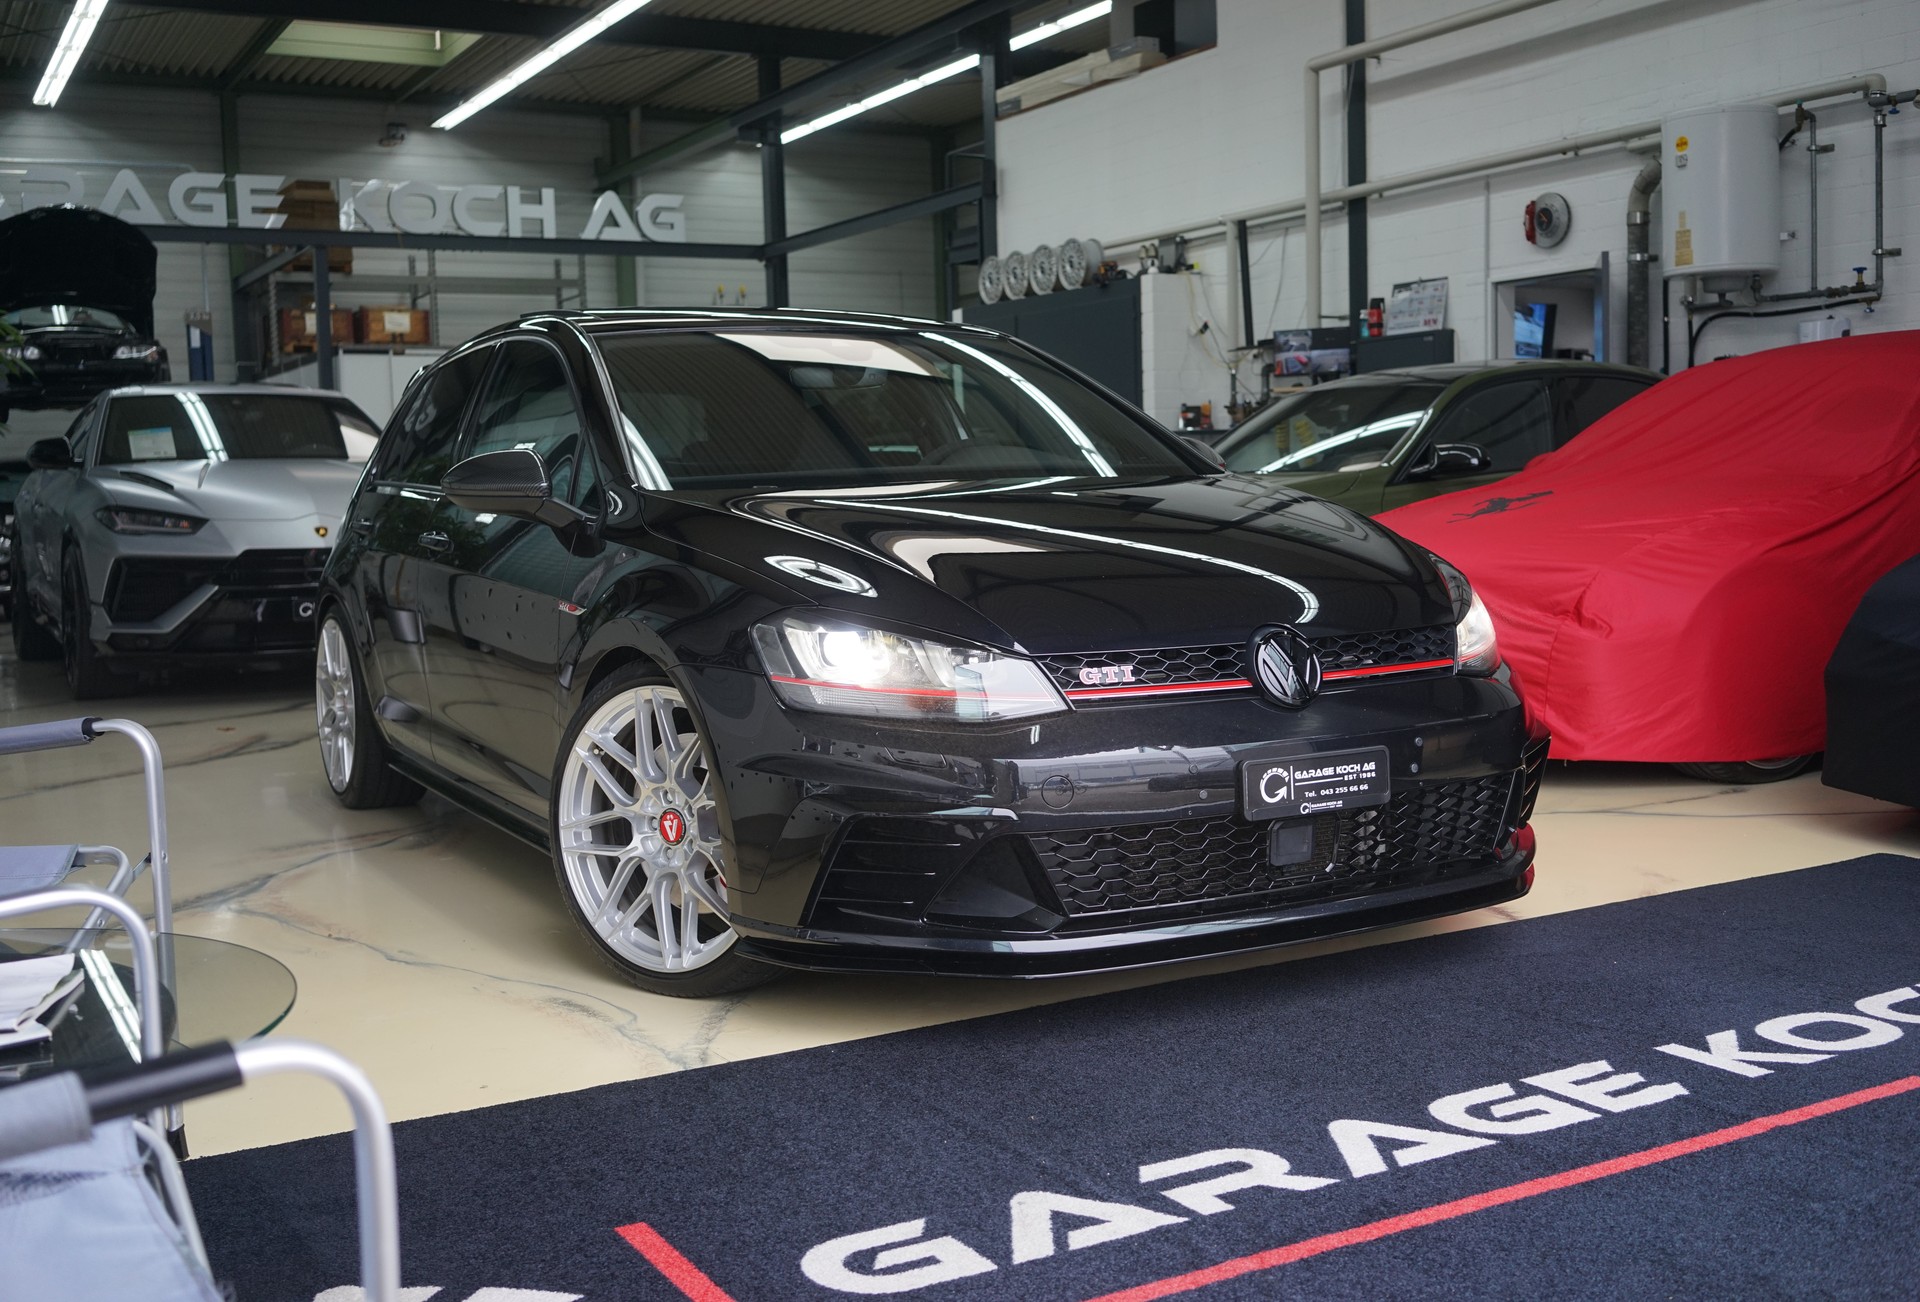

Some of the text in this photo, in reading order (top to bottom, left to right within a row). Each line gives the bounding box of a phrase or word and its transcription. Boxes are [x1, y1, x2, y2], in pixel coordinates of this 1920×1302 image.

[0, 166, 687, 243] RAGE KOCH AG
[1079, 666, 1135, 685] GTI
[1294, 761, 1376, 779] GARAGE KOCH AG
[1304, 783, 1369, 798] Tel. 043 255 66 66
[801, 984, 1920, 1295] GARAGE KOC
